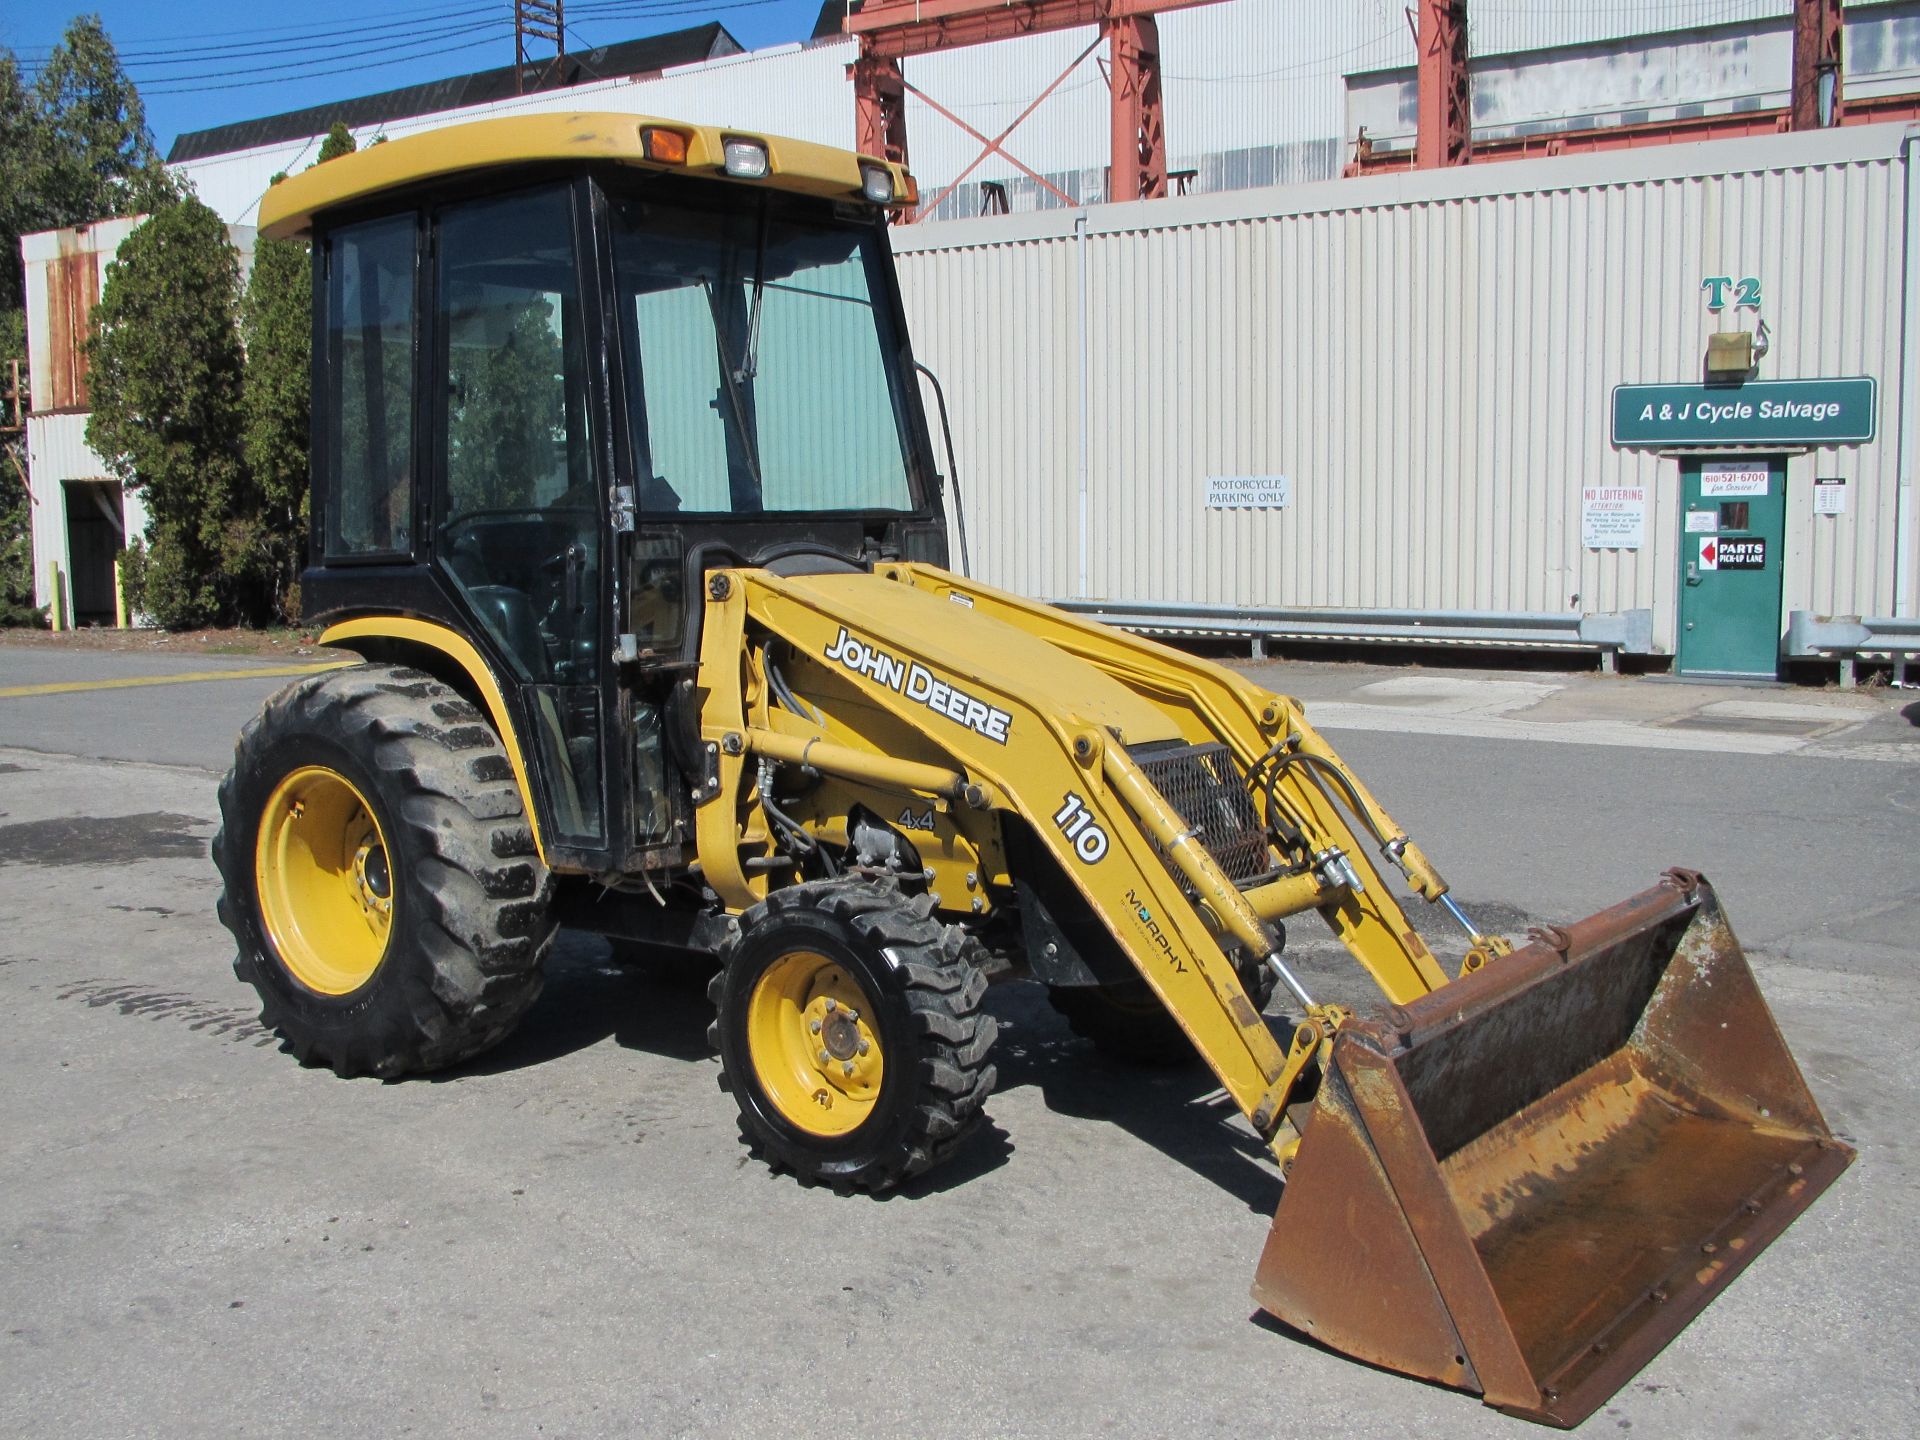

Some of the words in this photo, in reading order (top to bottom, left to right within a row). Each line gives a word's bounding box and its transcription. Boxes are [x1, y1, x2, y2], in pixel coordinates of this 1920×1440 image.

[1700, 276, 1762, 308] T2
[1639, 404, 1653, 421] A
[1659, 404, 1673, 421] &
[1678, 403, 1691, 420] J
[1695, 402, 1753, 423] Cycle
[1758, 401, 1840, 421] Salvage
[1212, 479, 1281, 490] MOTORCYCLE
[1711, 484, 1723, 494] for
[1209, 493, 1255, 503] PARKING
[1258, 492, 1286, 502] ONLY
[1584, 489, 1596, 501] NO
[1599, 489, 1643, 501] LOITERING
[1719, 544, 1764, 554] PARTS
[1719, 554, 1745, 563] PICK-UP
[1746, 554, 1764, 563] LANE
[824, 625, 906, 694] JOHN
[905, 660, 1013, 746] DEERE
[897, 807, 936, 832] 4x4
[1052, 790, 1110, 866] 110
